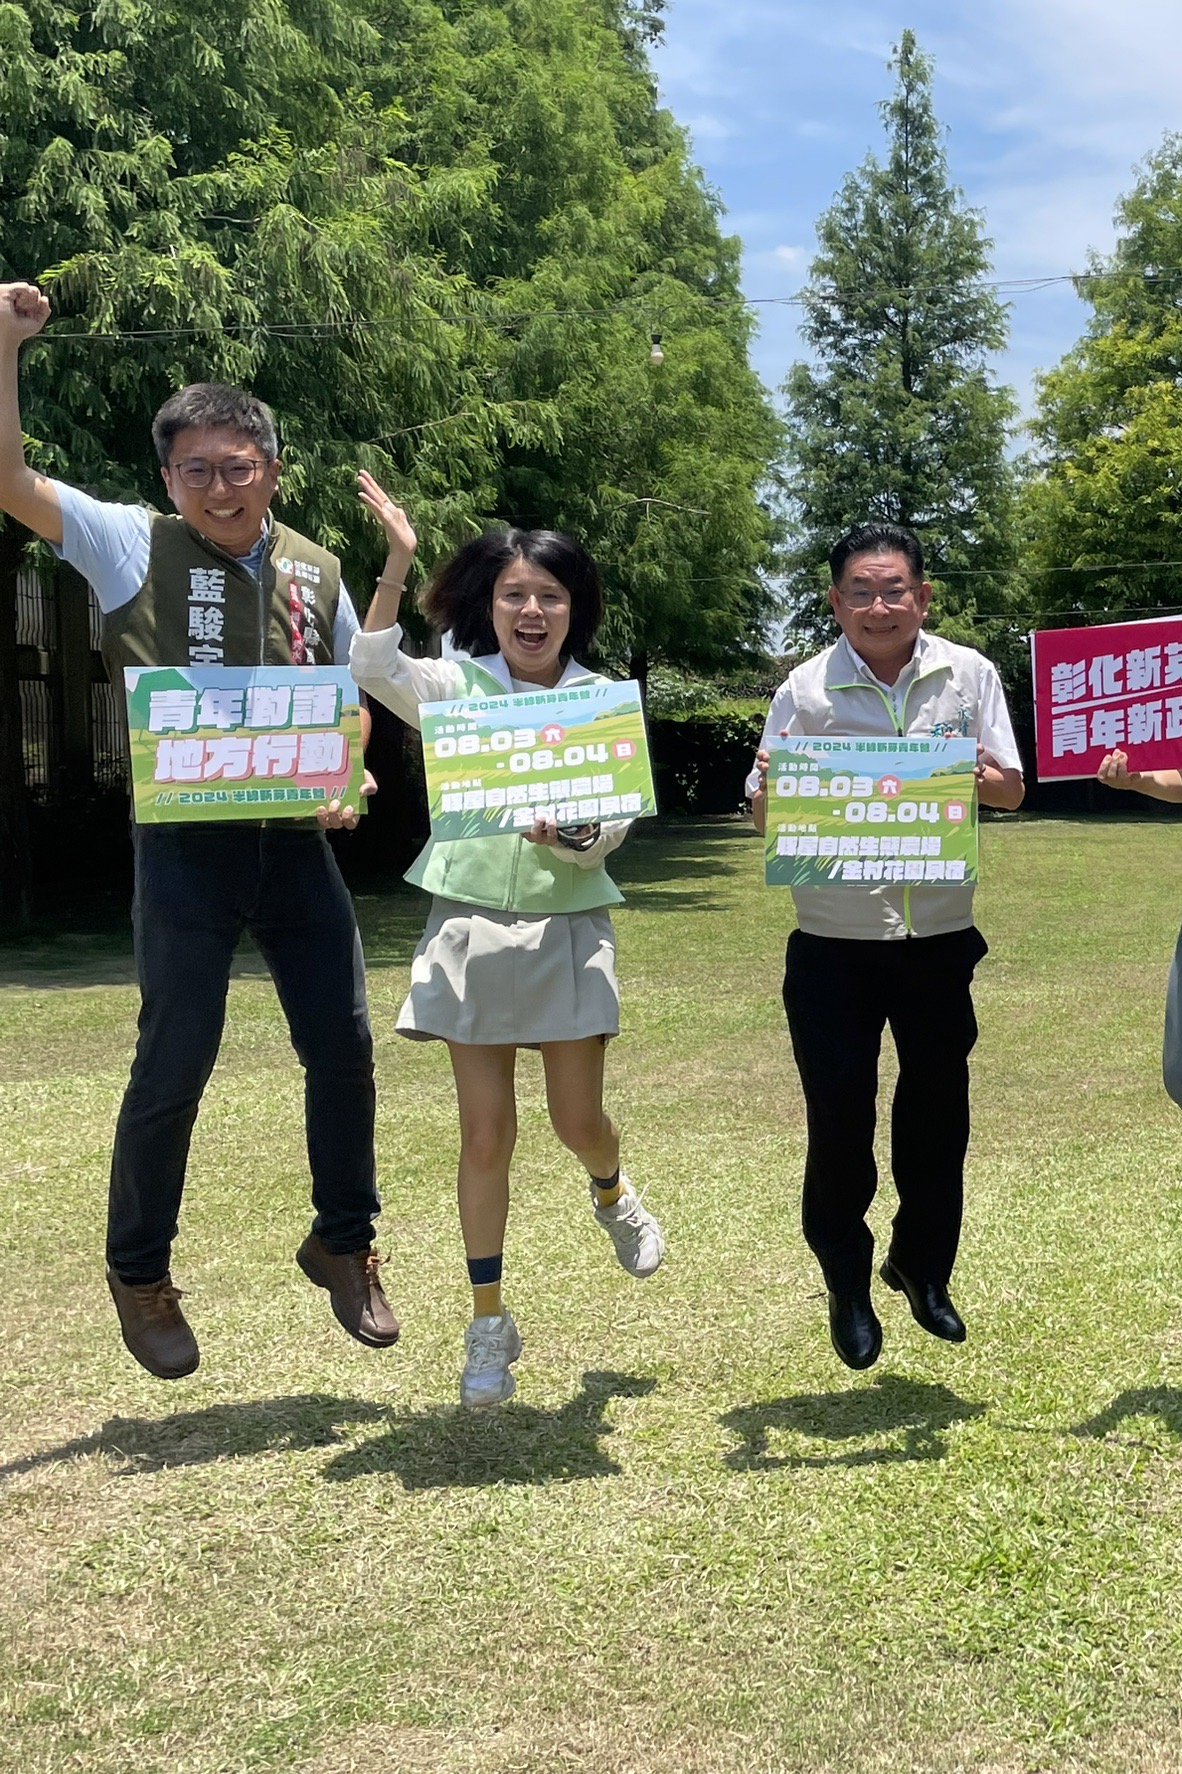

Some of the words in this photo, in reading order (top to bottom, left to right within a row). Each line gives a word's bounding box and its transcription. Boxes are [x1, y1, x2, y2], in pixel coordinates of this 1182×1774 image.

[149, 683, 341, 733] 青年對話
[468, 700, 509, 712] 2024
[434, 728, 536, 758] 08.03
[544, 726, 562, 743] 六
[615, 742, 632, 757] 日
[812, 742, 851, 753] 2024
[154, 733, 347, 781] 地方行動
[777, 762, 819, 771] 活動時間
[775, 775, 873, 797] 08.03
[882, 779, 898, 795] 六
[178, 790, 228, 804] 2024
[947, 805, 963, 820] 日
